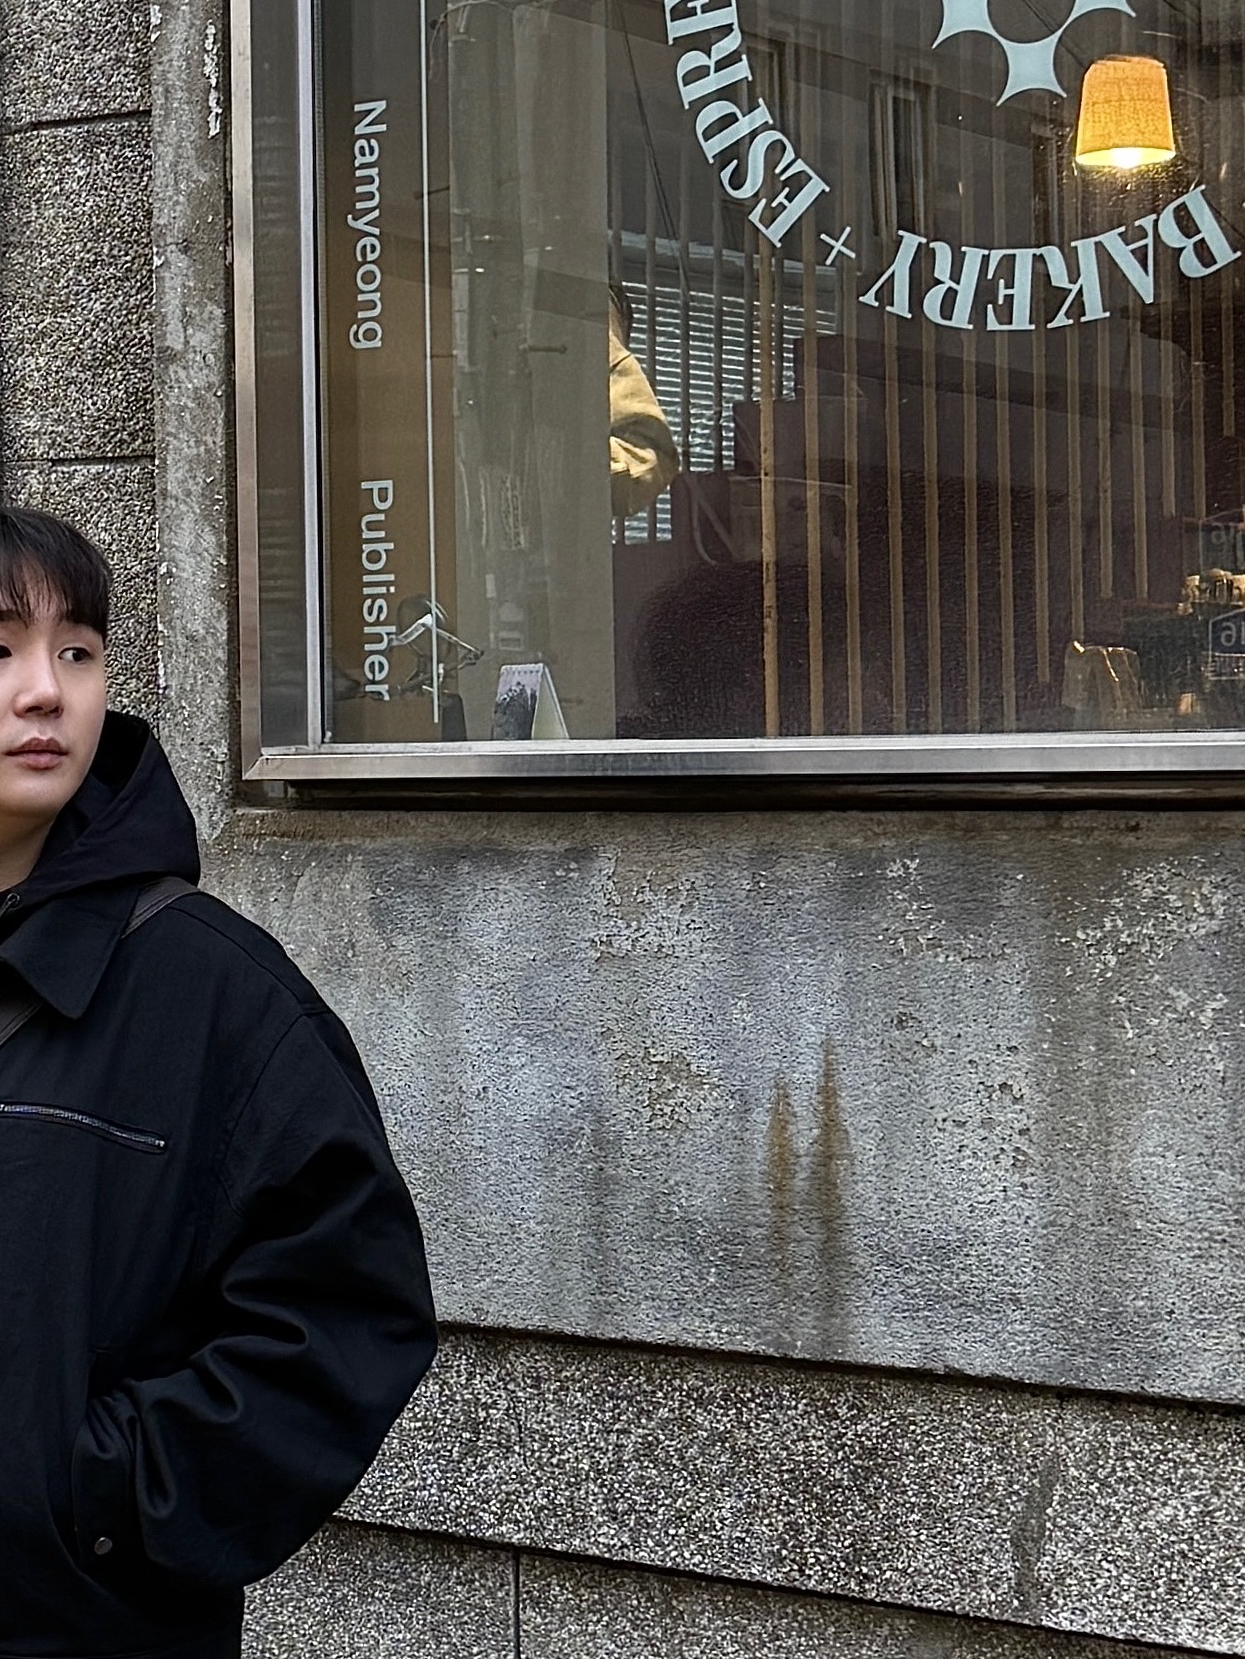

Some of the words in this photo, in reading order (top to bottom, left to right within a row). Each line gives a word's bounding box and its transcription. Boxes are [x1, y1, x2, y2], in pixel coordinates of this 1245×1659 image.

[347, 100, 388, 350] Namyeong
[859, 185, 1242, 332] BAKERY
[361, 480, 397, 701] Publisher
